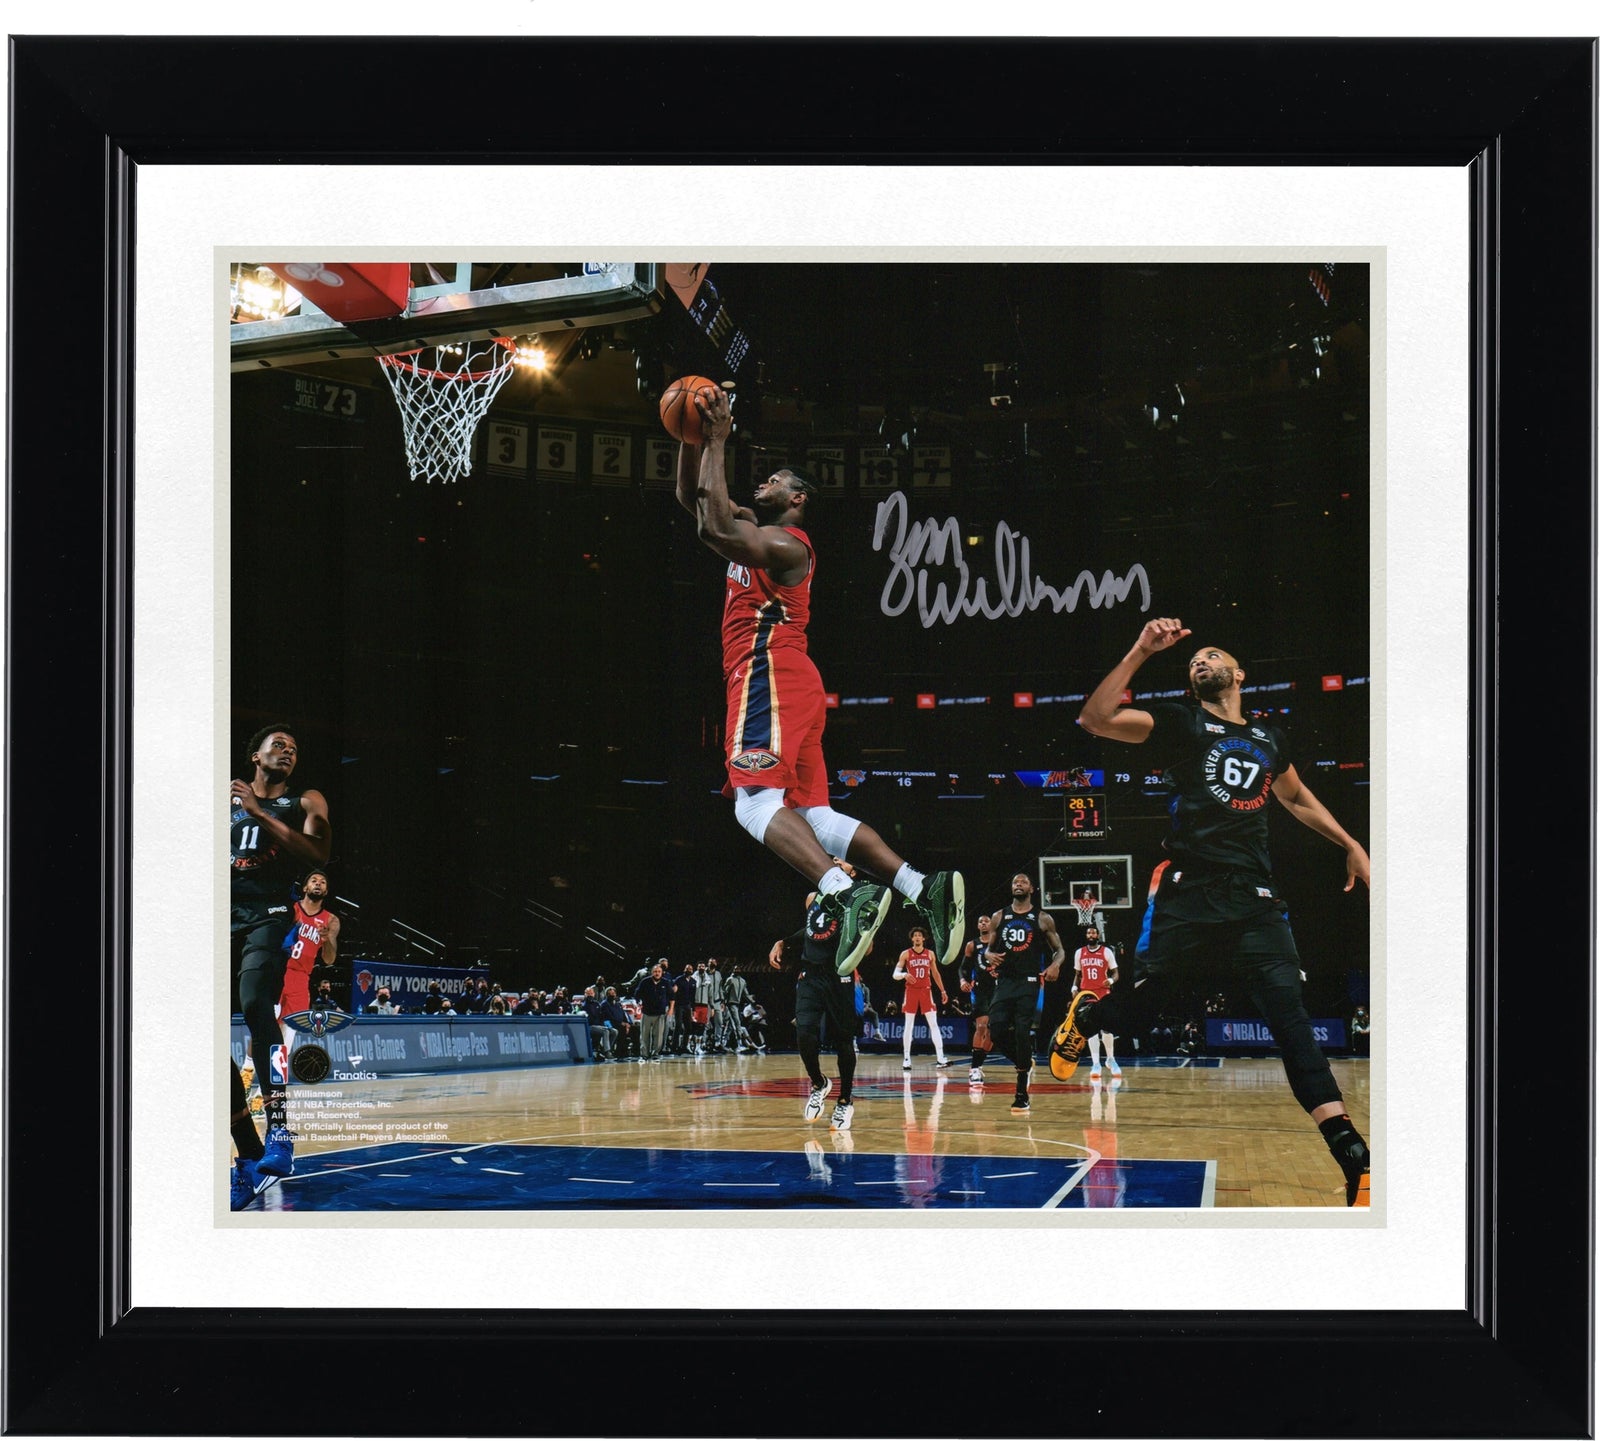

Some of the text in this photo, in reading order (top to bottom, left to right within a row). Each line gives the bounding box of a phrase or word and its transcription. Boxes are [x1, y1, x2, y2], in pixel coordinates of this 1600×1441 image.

[295, 378, 321, 395] BILLY
[295, 393, 318, 409] JOEL
[323, 385, 357, 416] 73
[499, 437, 516, 464] 3
[548, 441, 566, 468] 9
[603, 447, 620, 474] 2
[656, 451, 673, 478] 9
[864, 459, 894, 486] 19
[924, 458, 941, 485] 7
[1218, 739, 1252, 752] SLEEPS
[1205, 749, 1222, 781] NEVER
[1223, 757, 1260, 789] 67
[897, 777, 912, 787] 16
[1115, 773, 1131, 783] 79
[1209, 784, 1231, 803] CITY
[1069, 798, 1094, 809] 28.7
[1231, 795, 1265, 811] KNICKS
[1072, 810, 1099, 828] 21
[239, 825, 260, 850] 11
[815, 912, 825, 928] 4
[1008, 928, 1025, 942] 30
[291, 940, 304, 959] 8
[915, 968, 925, 979] 10
[1087, 967, 1098, 980] 16
[374, 975, 402, 992] NEW
[891, 1022, 927, 1039] Leue
[1233, 1023, 1255, 1041] NBA
[327, 1035, 353, 1063] More
[353, 1034, 374, 1061] Live
[375, 1034, 406, 1061] Games
[426, 1032, 489, 1062] NBA League Pass
[498, 1031, 570, 1054] Watch More Live Games
